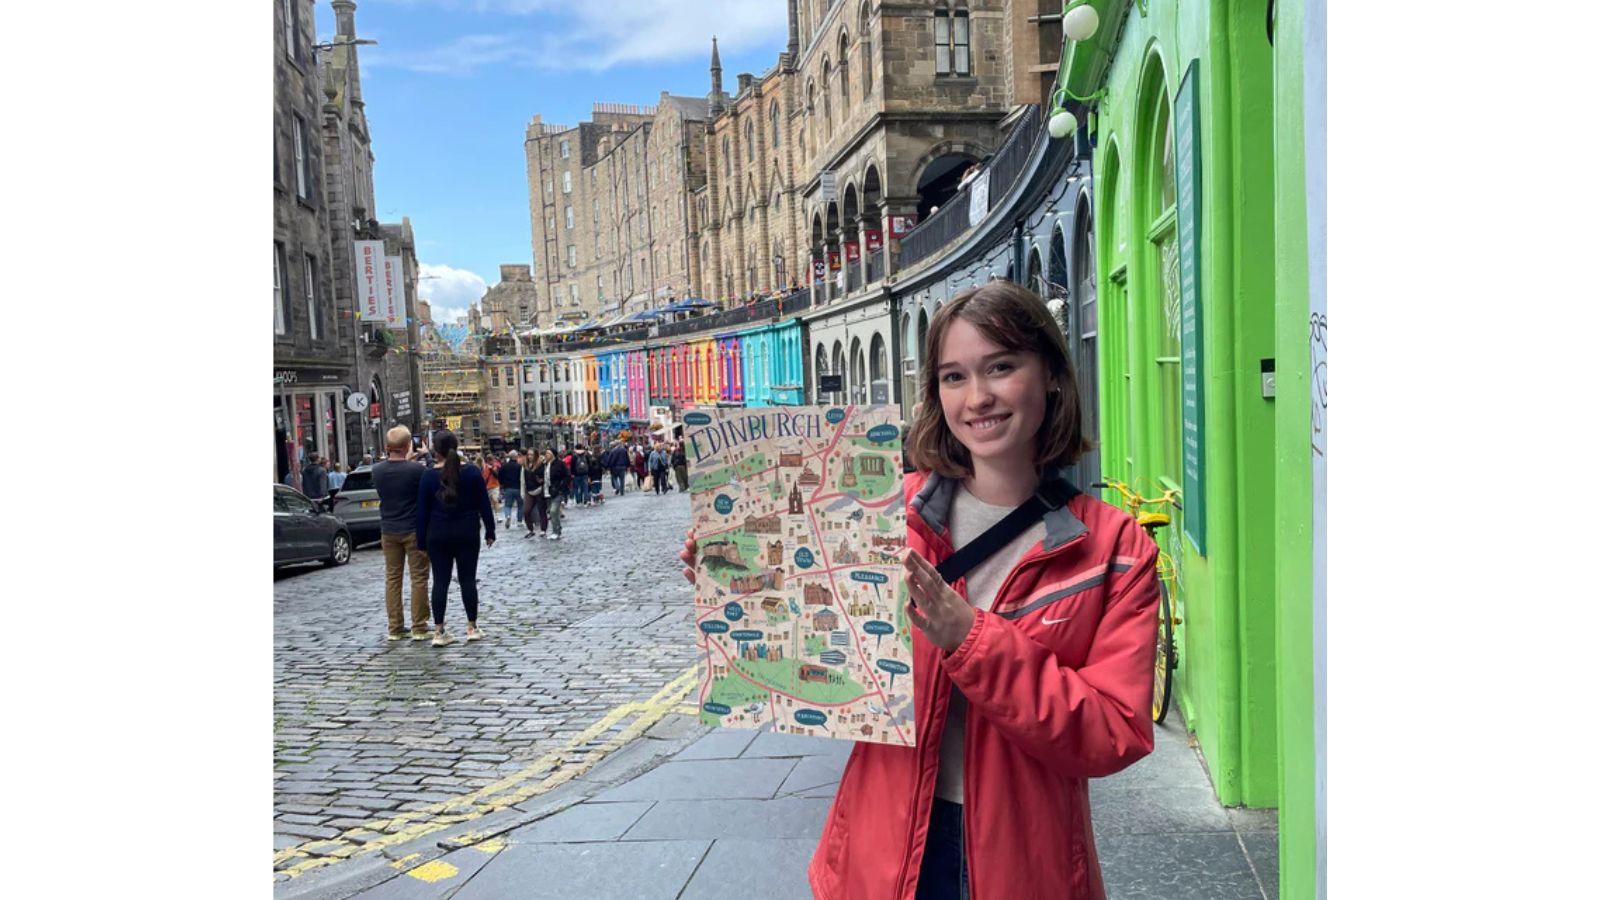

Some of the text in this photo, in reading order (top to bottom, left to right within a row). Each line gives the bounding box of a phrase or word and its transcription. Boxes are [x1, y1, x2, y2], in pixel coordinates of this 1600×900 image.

[363, 246, 376, 316] BERTIES
[356, 397, 365, 407] K
[688, 412, 822, 464] EDINBURGH
